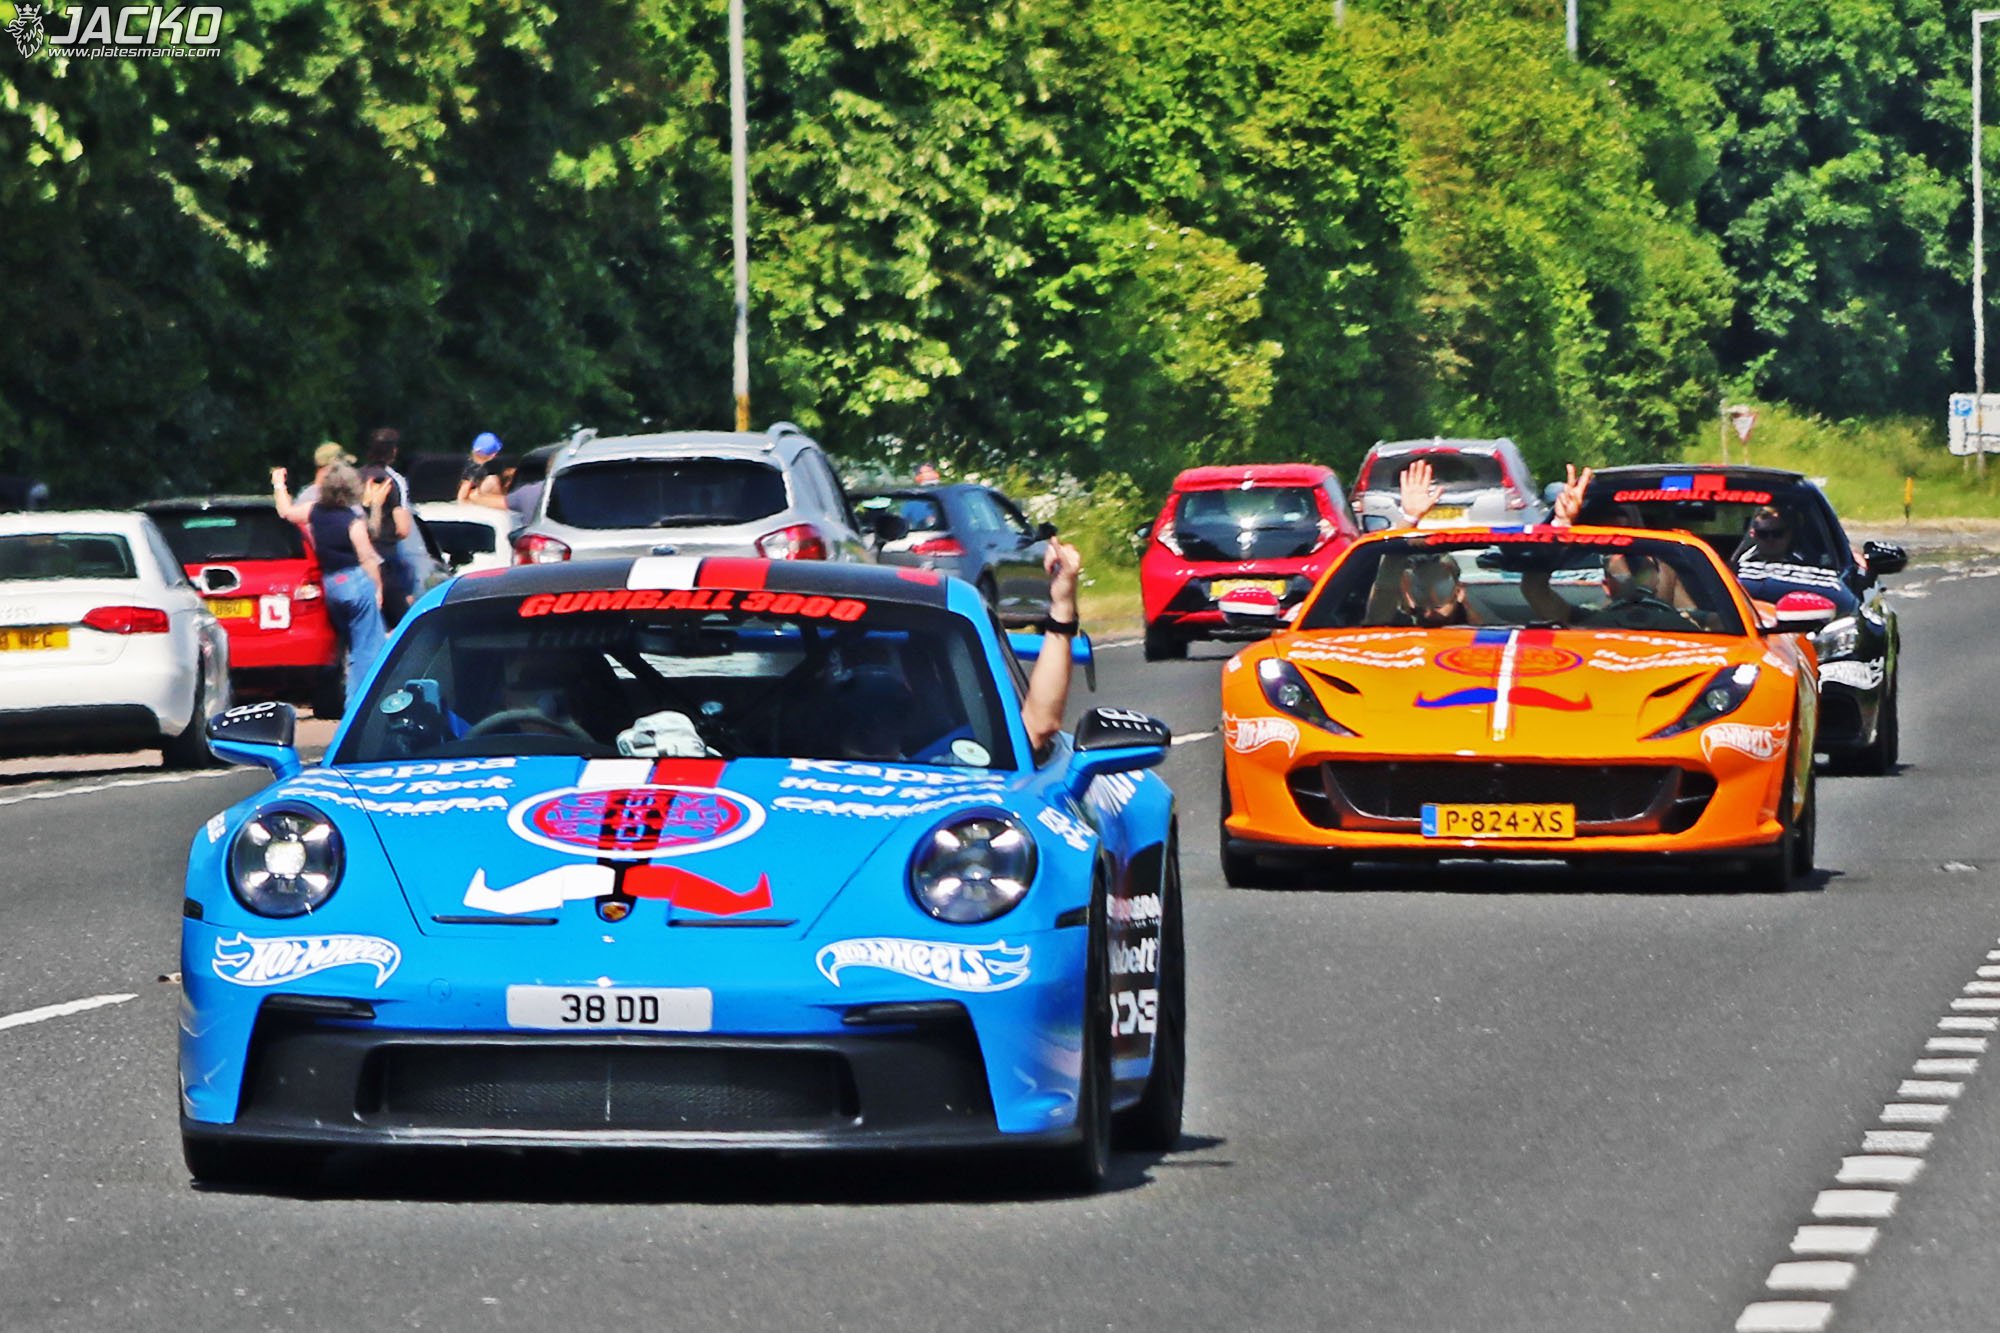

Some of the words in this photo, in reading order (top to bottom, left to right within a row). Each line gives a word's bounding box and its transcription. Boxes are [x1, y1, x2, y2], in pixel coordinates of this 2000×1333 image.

[268, 606, 282, 620] L
[518, 590, 734, 617] GUMBALL
[740, 592, 867, 621] 3000
[789, 758, 1004, 785] Kappa
[1446, 810, 1563, 833] P-824-XS
[561, 994, 605, 1023] 38
[616, 996, 659, 1024] DD
